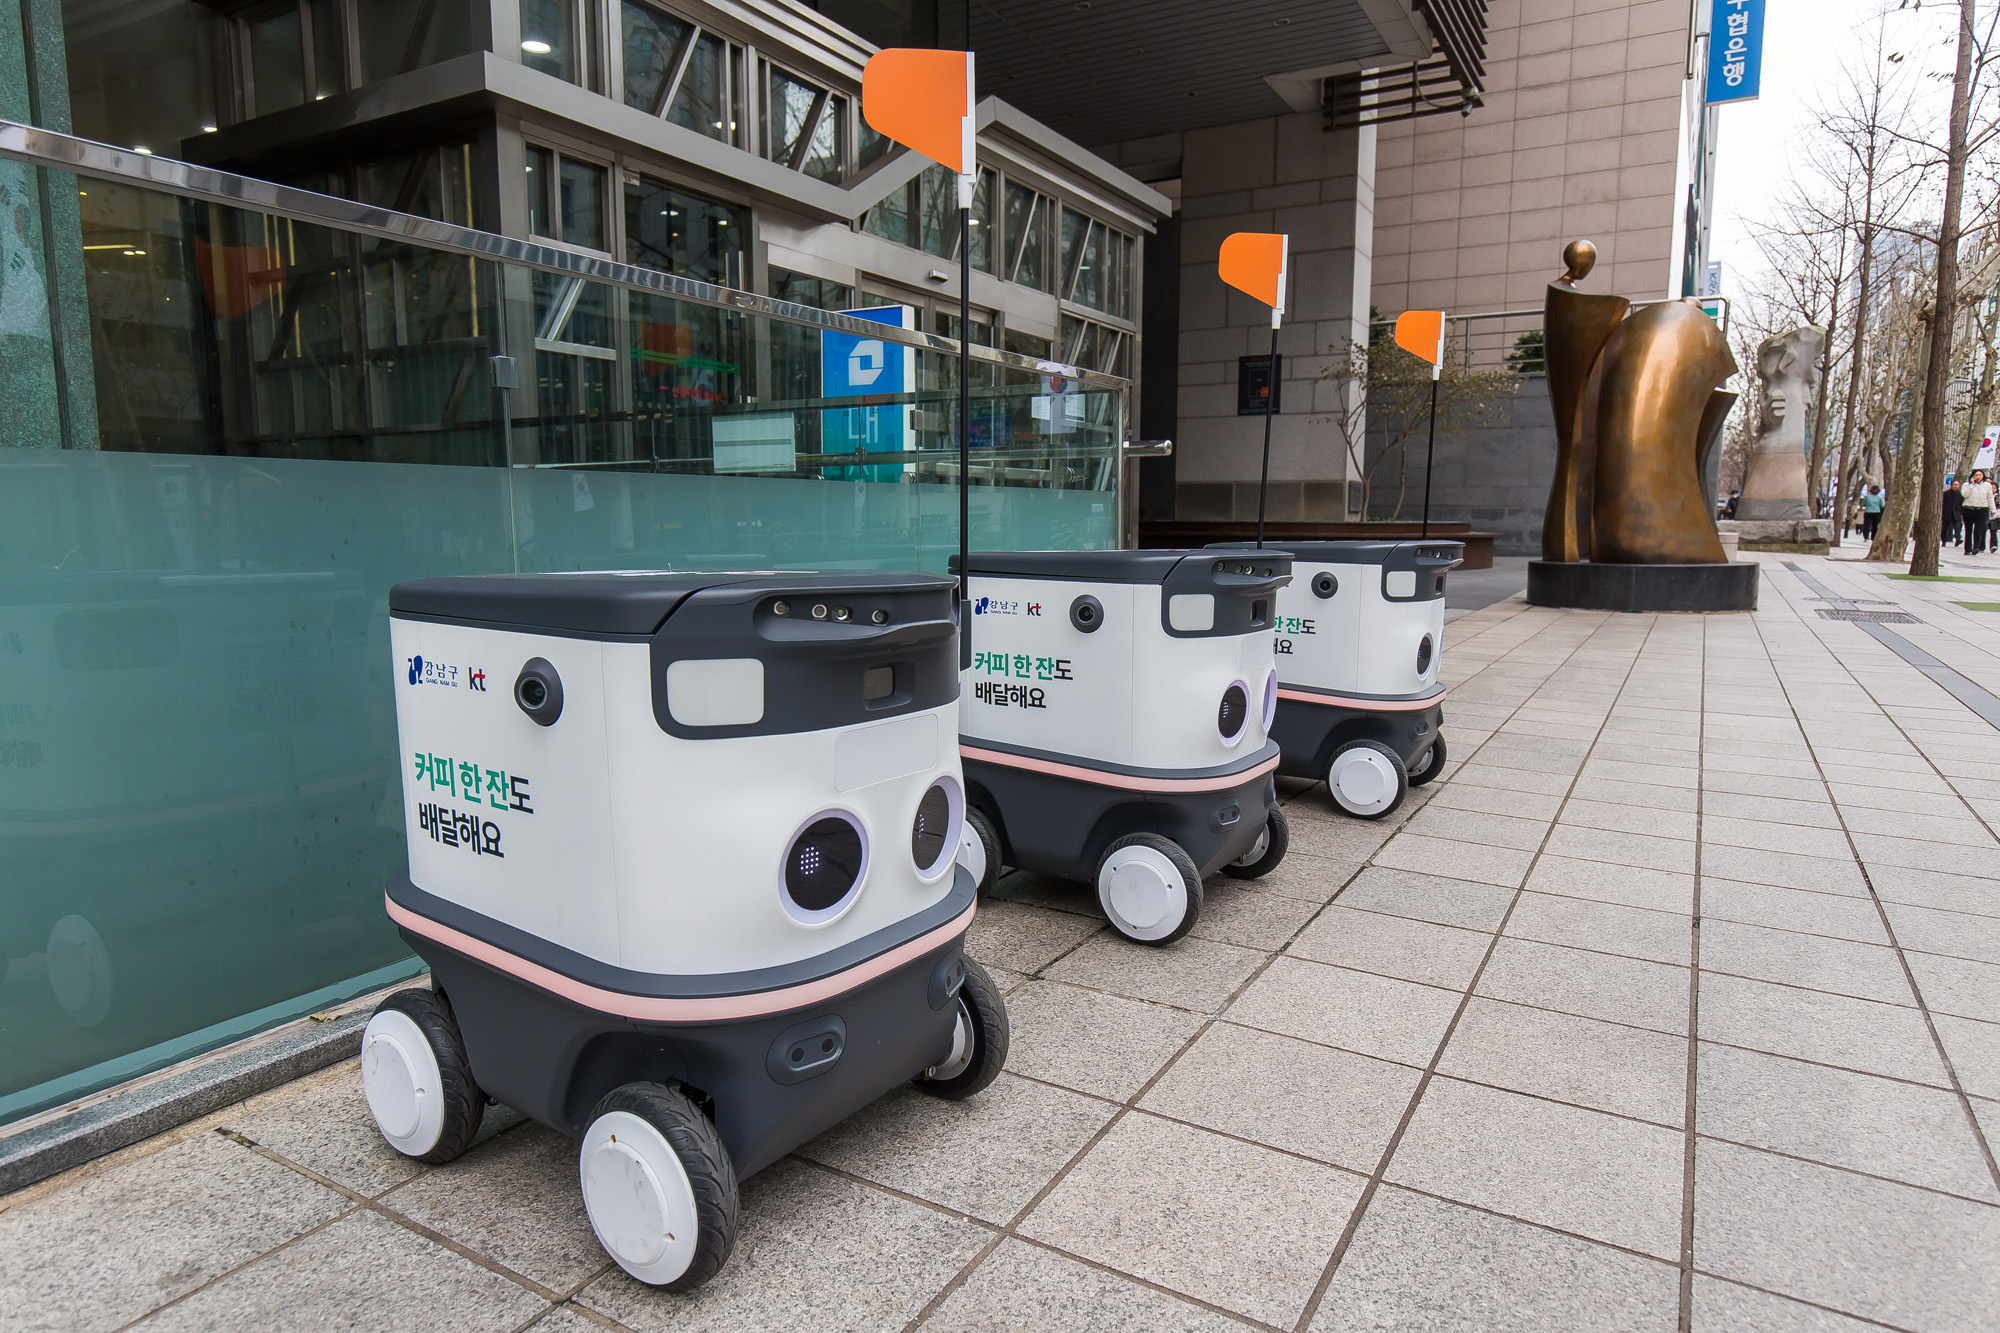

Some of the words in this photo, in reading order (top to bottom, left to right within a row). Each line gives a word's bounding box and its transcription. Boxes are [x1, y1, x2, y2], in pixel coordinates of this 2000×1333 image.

[1722, 0, 1751, 87] 협은행
[989, 600, 1019, 611] 강남구
[1027, 602, 1042, 616] kt
[1285, 617, 1316, 635] 잔도
[424, 661, 459, 680] 강남구
[468, 666, 486, 692] kt
[975, 652, 1009, 677] 커피
[1013, 654, 1033, 679] 한
[1035, 657, 1073, 681] 잔도
[426, 677, 438, 685] GANG
[975, 682, 1047, 709] 배달해요
[415, 752, 456, 797] 커피
[459, 761, 482, 804] 한
[486, 769, 534, 815] 잔도
[418, 802, 505, 858] 배달해요
